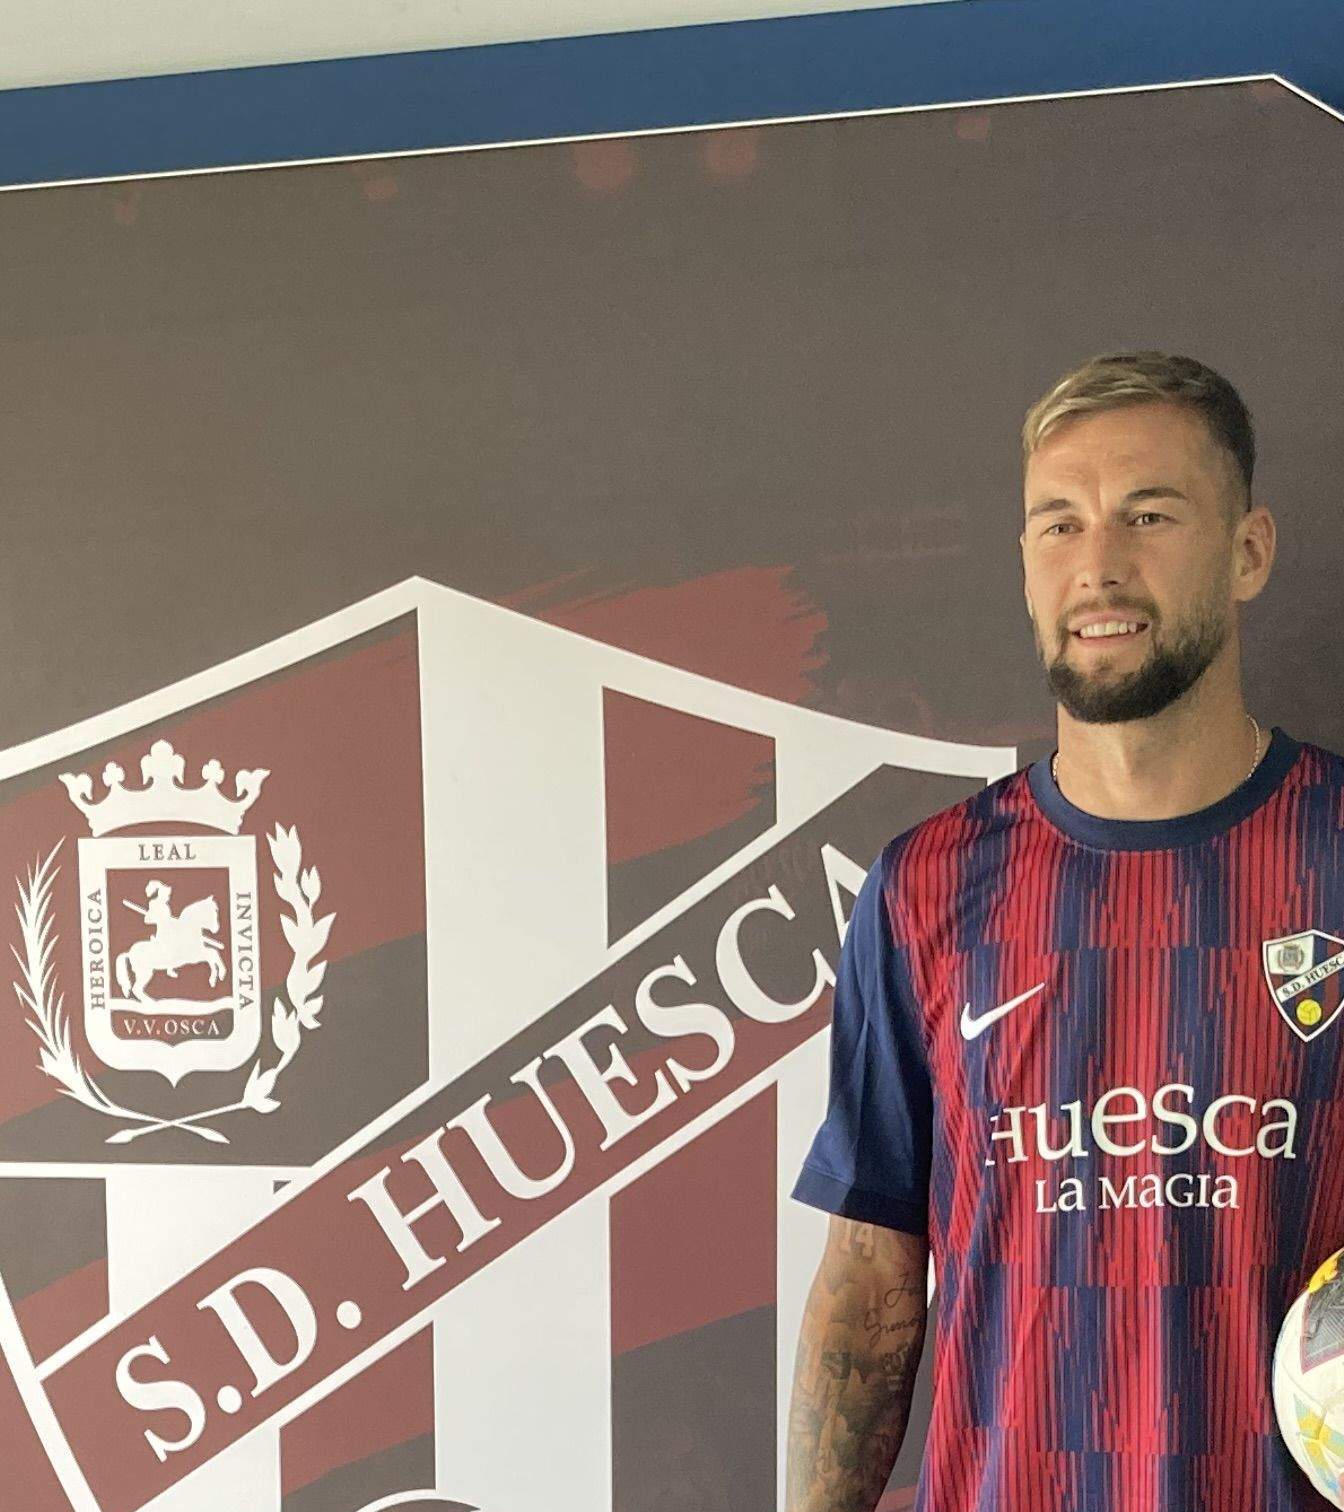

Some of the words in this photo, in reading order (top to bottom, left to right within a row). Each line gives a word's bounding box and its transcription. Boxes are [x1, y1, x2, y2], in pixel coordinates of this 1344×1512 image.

[139, 844, 196, 861] LEAL
[87, 887, 106, 1010] HEROICA
[236, 893, 254, 1009] INVICTA
[1035, 1177, 1086, 1214] La
[115, 1267, 362, 1462] S.D.
